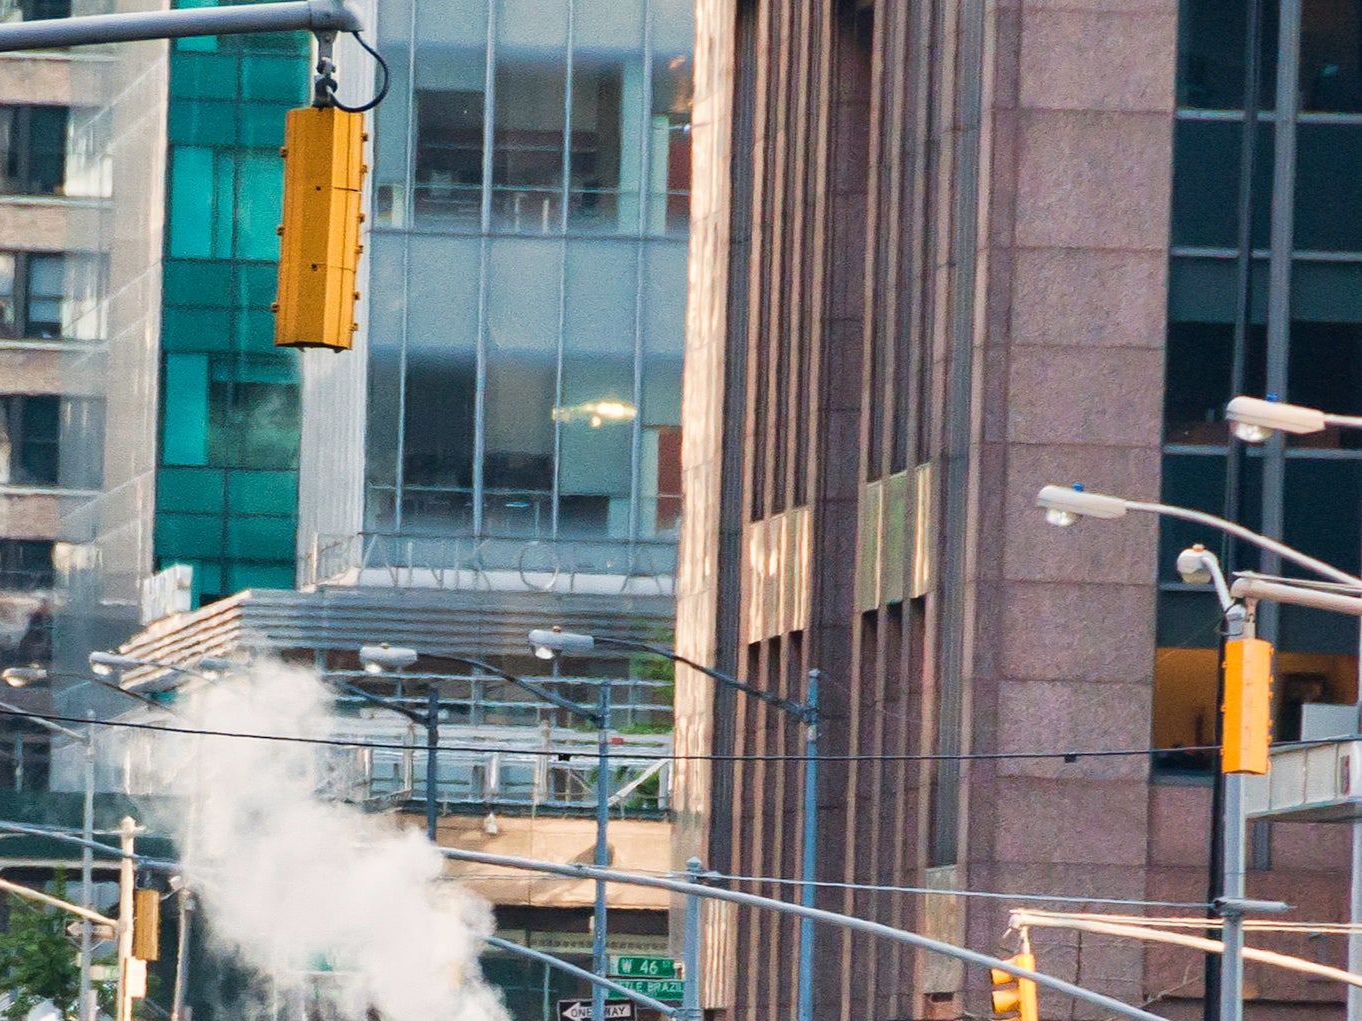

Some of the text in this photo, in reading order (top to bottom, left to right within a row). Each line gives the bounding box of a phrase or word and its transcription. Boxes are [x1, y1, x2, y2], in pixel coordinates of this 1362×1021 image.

[621, 959, 633, 973] W
[639, 960, 658, 975] 46
[571, 1008, 591, 1017] ONE
